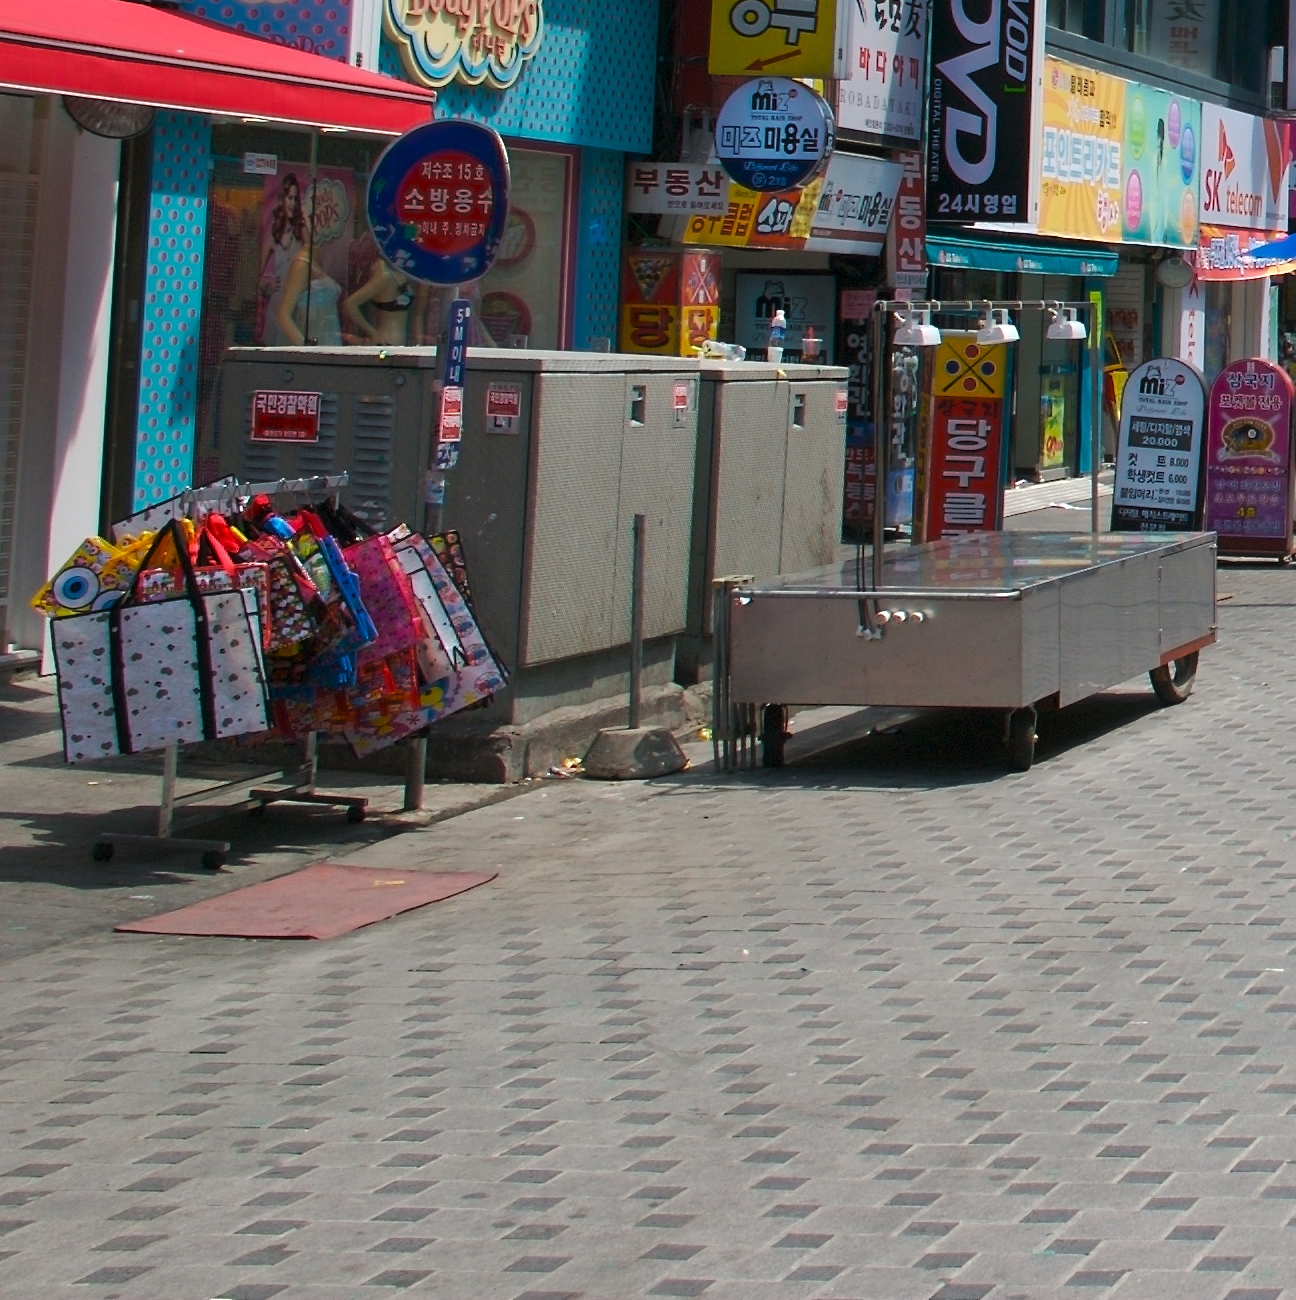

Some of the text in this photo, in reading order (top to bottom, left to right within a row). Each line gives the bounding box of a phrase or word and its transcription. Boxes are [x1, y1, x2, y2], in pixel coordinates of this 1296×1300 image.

[751, 91, 792, 112] miz
[838, 88, 918, 118] ROBADAYAKI
[721, 122, 820, 156] 미즈 미용실
[930, 77, 943, 182] DIGITAL THEATER
[421, 160, 485, 183] 저수조 15 호
[1042, 125, 1122, 189] 포인트리카드
[633, 168, 725, 197] 부동산
[1204, 168, 1263, 218] SK telecom
[403, 184, 493, 213] 소방용수
[860, 191, 894, 229] 미용실
[937, 192, 1018, 215] 24시영업
[629, 306, 677, 348] 당
[1139, 376, 1176, 397] miz
[1228, 372, 1276, 390] 삼국지
[1218, 393, 1283, 411] 포켓볼 전용
[1126, 469, 1165, 484] 학생컷트
